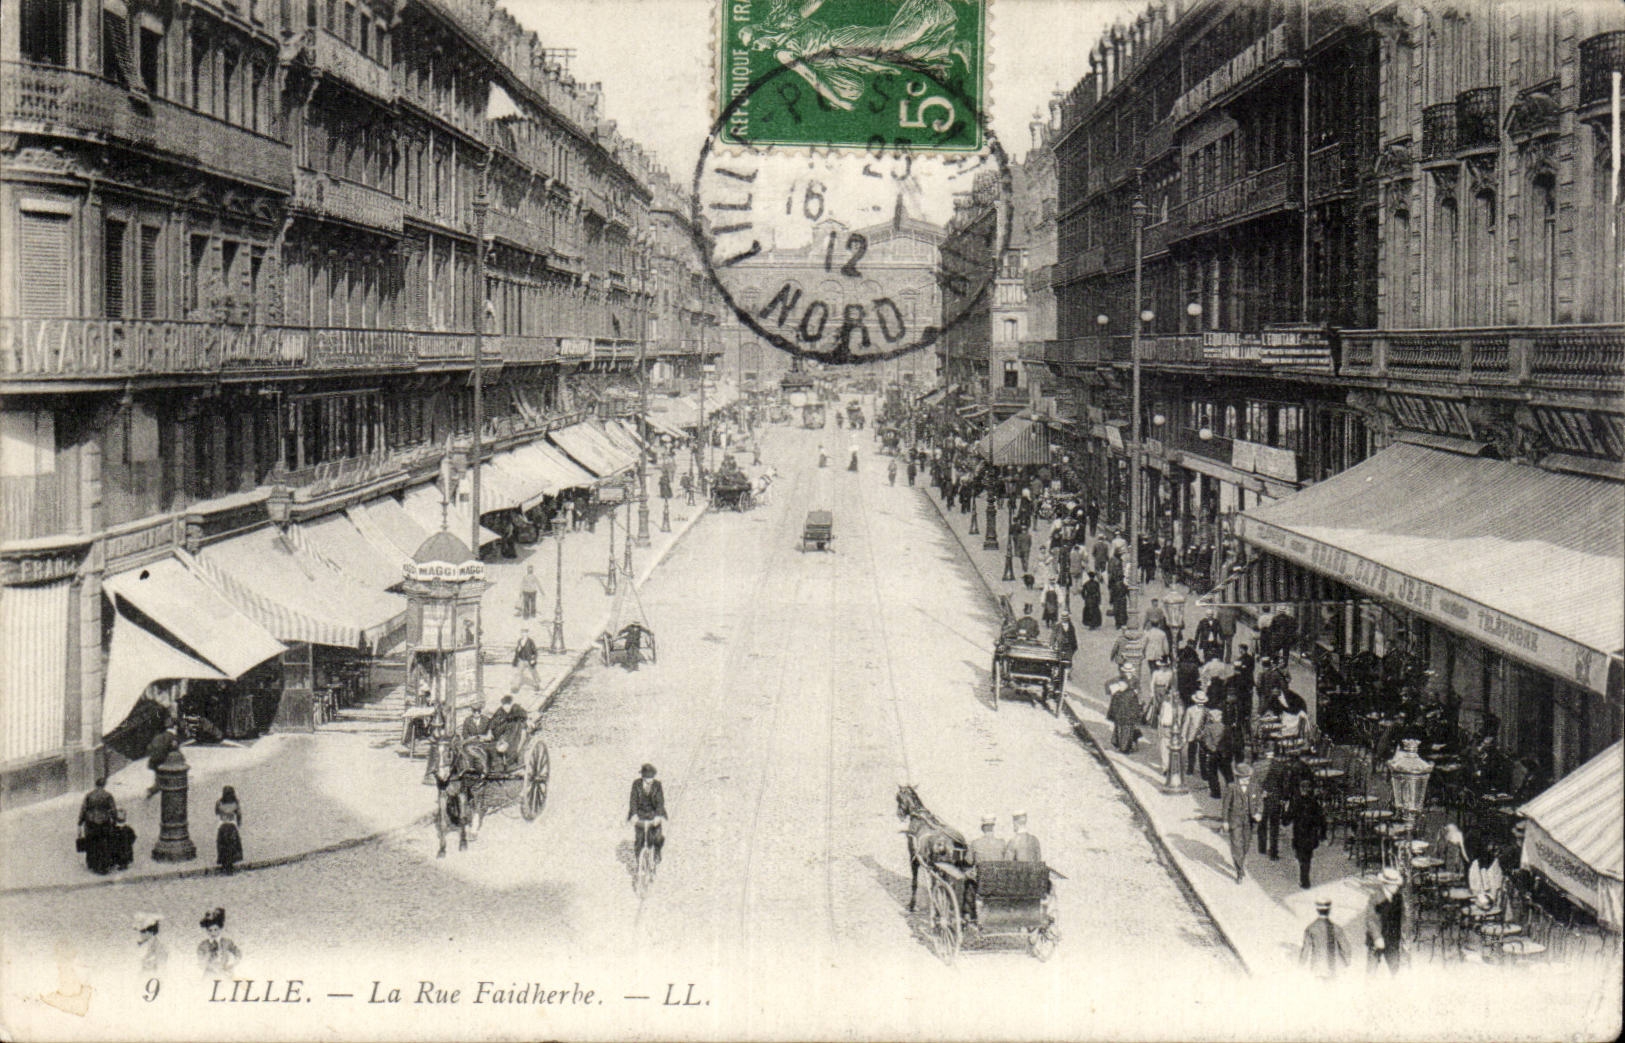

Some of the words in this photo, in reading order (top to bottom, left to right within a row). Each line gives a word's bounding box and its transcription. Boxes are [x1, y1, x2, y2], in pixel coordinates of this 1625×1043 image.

[733, 0, 752, 21] FR
[825, 231, 868, 277] 12
[759, 283, 906, 347] NORD
[418, 566, 456, 576] MAGGI
[459, 565, 484, 576] MAGGI
